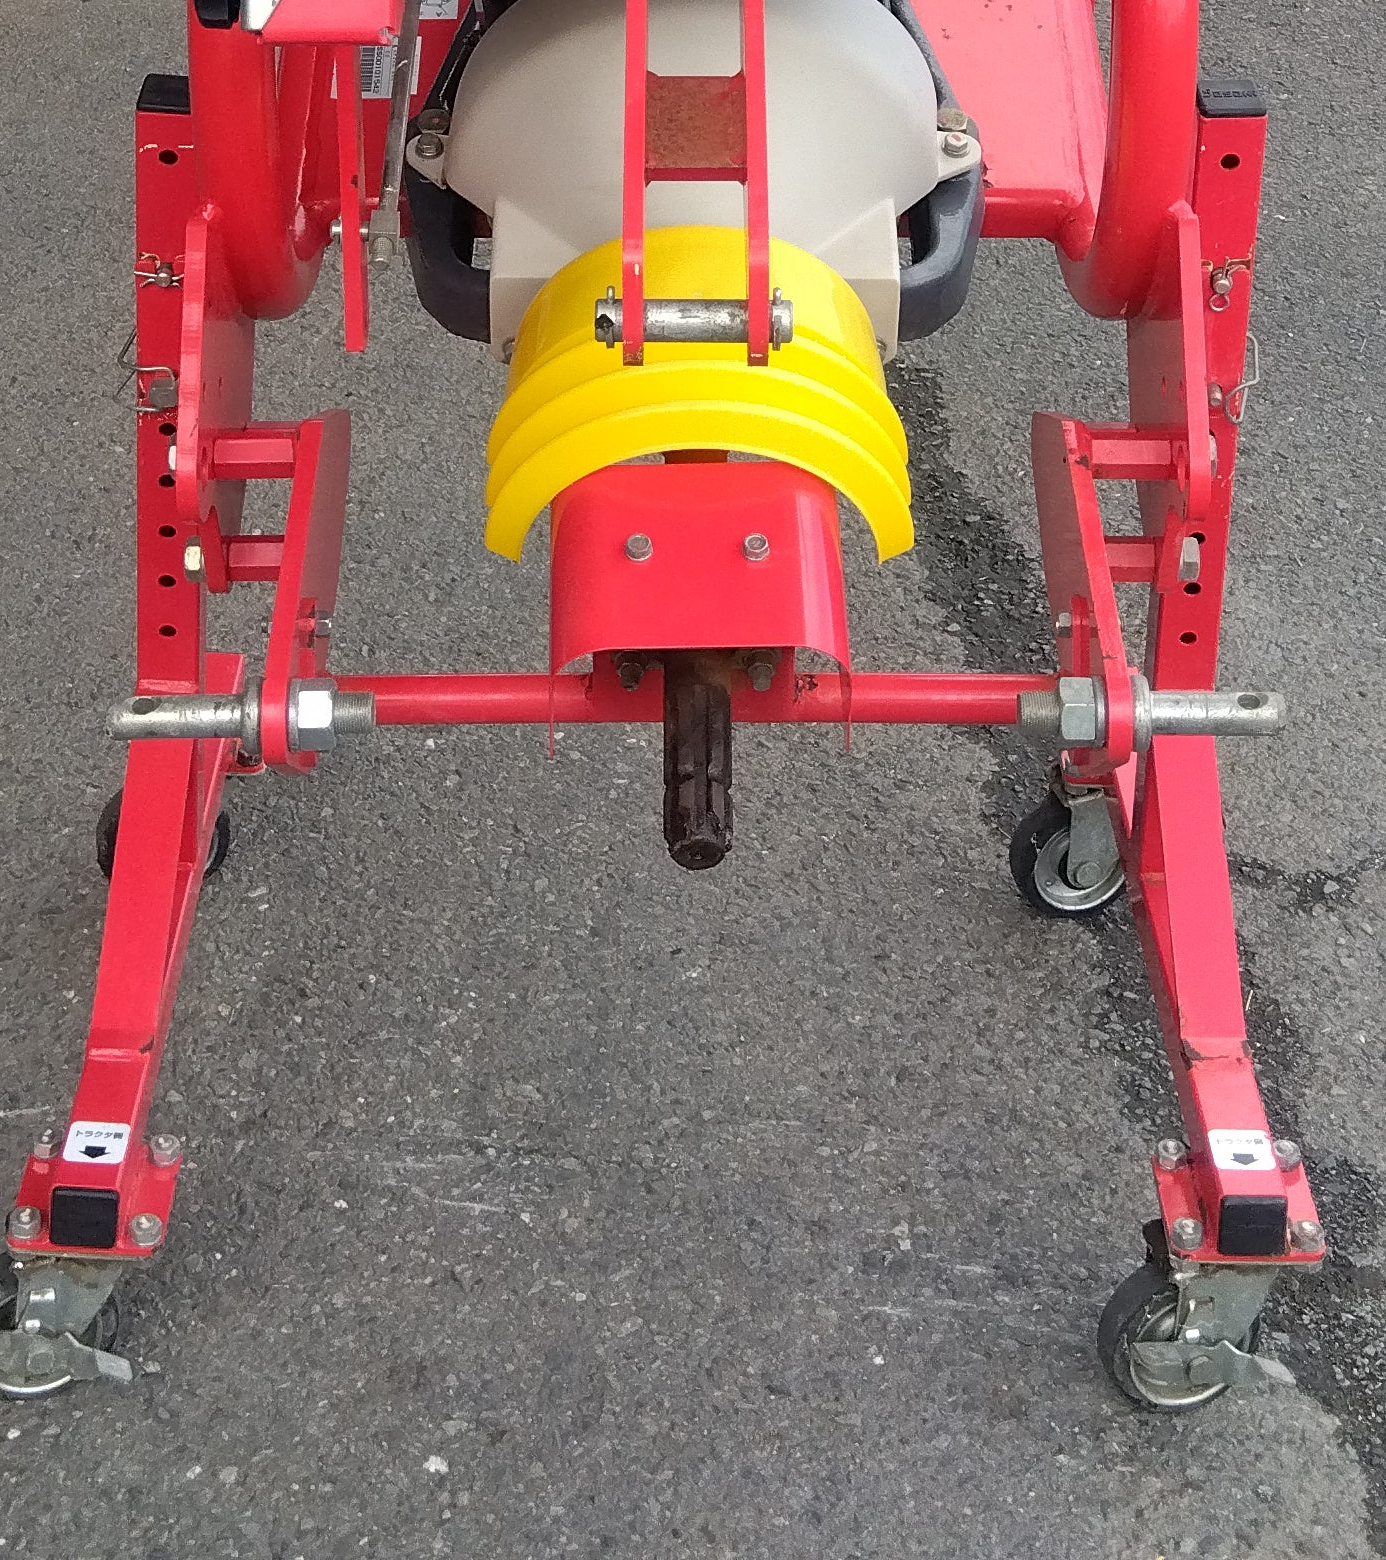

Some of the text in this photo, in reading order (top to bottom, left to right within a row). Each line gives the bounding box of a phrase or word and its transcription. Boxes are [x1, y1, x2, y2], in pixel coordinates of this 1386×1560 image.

[76, 1130, 124, 1139] トラクタ側
